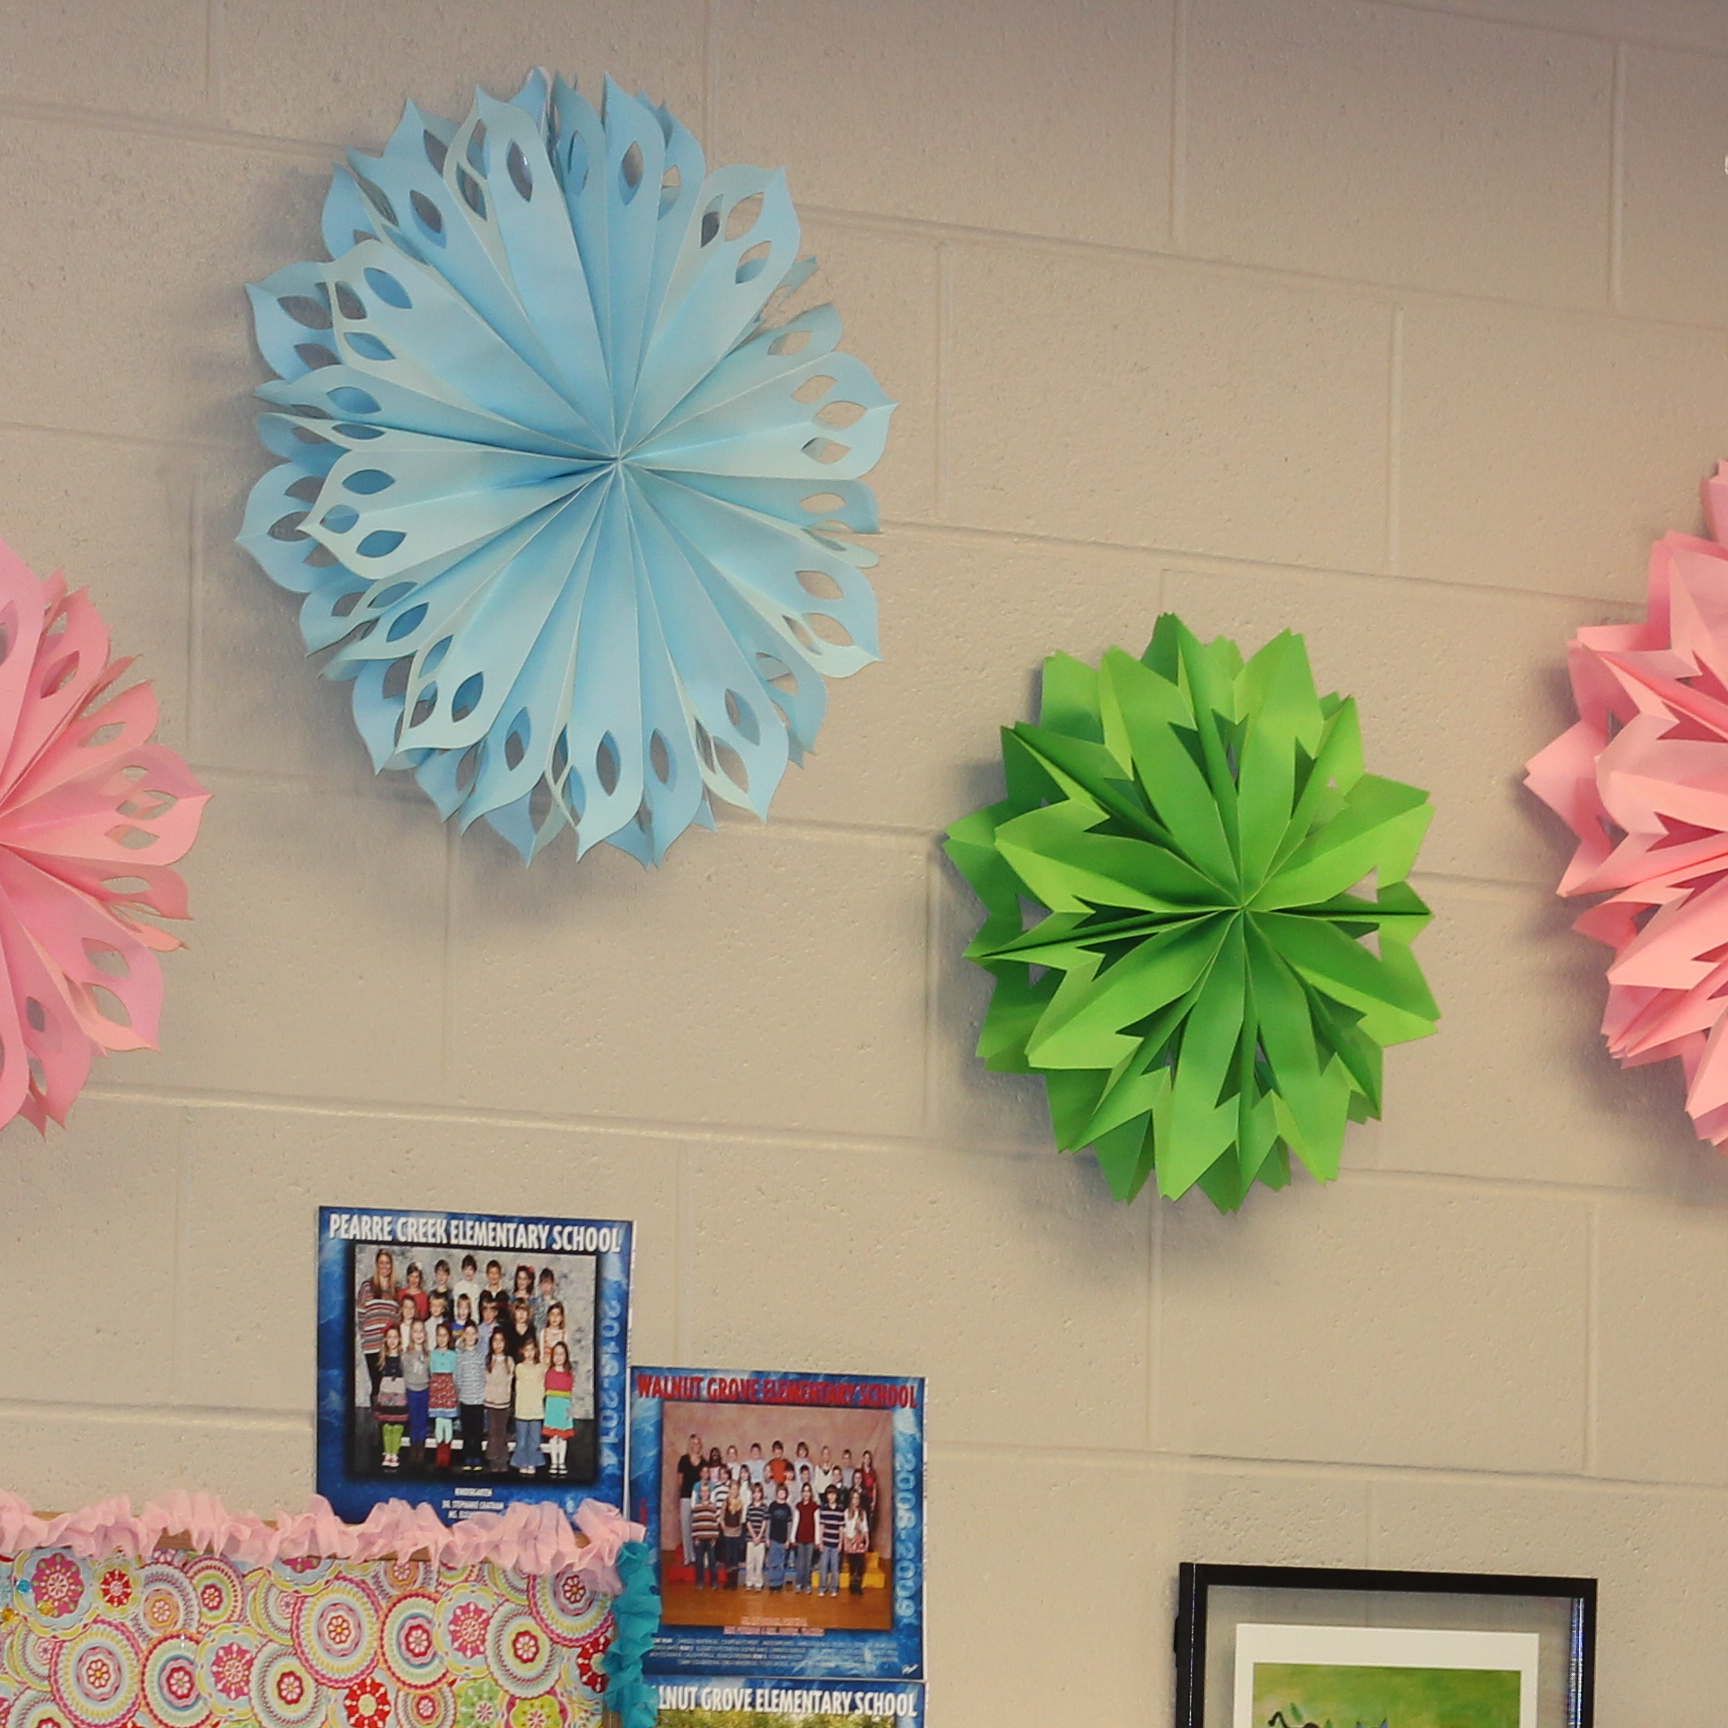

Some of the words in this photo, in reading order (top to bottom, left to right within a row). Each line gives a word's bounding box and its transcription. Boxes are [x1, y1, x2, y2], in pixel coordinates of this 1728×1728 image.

[329, 1213, 393, 1242] PEARRE
[396, 1217, 449, 1245] CREEK
[450, 1219, 551, 1250] ELEMENTARY
[552, 1225, 622, 1254] SCHOOL
[636, 1374, 704, 1400] WALNUT
[707, 1377, 759, 1402] GROVE
[762, 1379, 858, 1406] ELEMENTARY
[858, 1382, 919, 1409] SCHOOL
[657, 1685, 699, 1712] LNUT
[701, 1686, 754, 1712] GROVE
[755, 1688, 853, 1714] ELEMENTARY
[854, 1691, 919, 1717] SCHOOL
